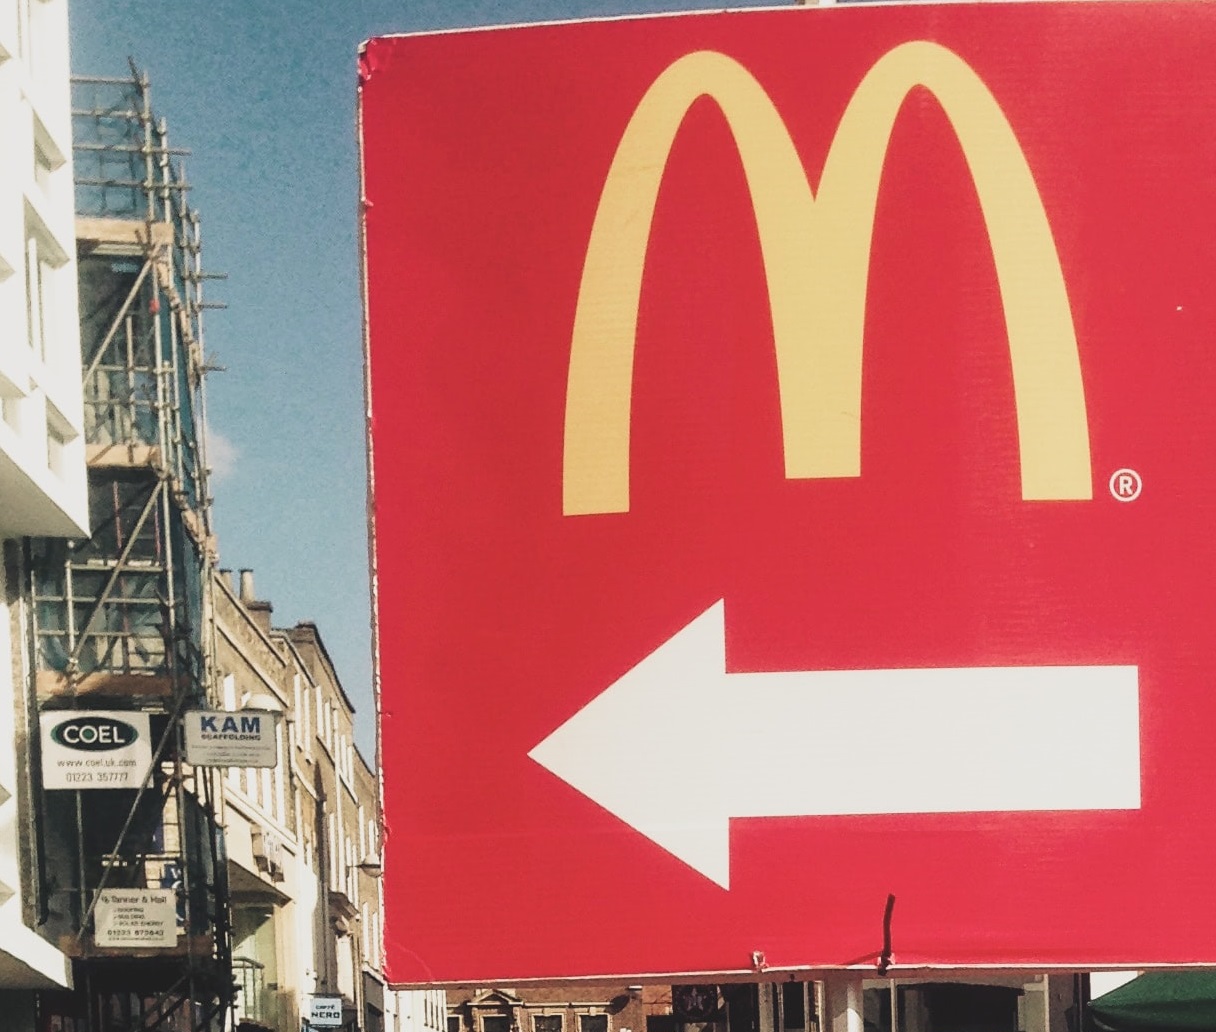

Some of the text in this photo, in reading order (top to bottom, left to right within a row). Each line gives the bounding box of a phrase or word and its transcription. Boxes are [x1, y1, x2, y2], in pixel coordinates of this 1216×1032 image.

[201, 716, 260, 733] KAM
[63, 725, 126, 744] COEL
[66, 772, 93, 782] 01223
[311, 1011, 340, 1019] NERO
